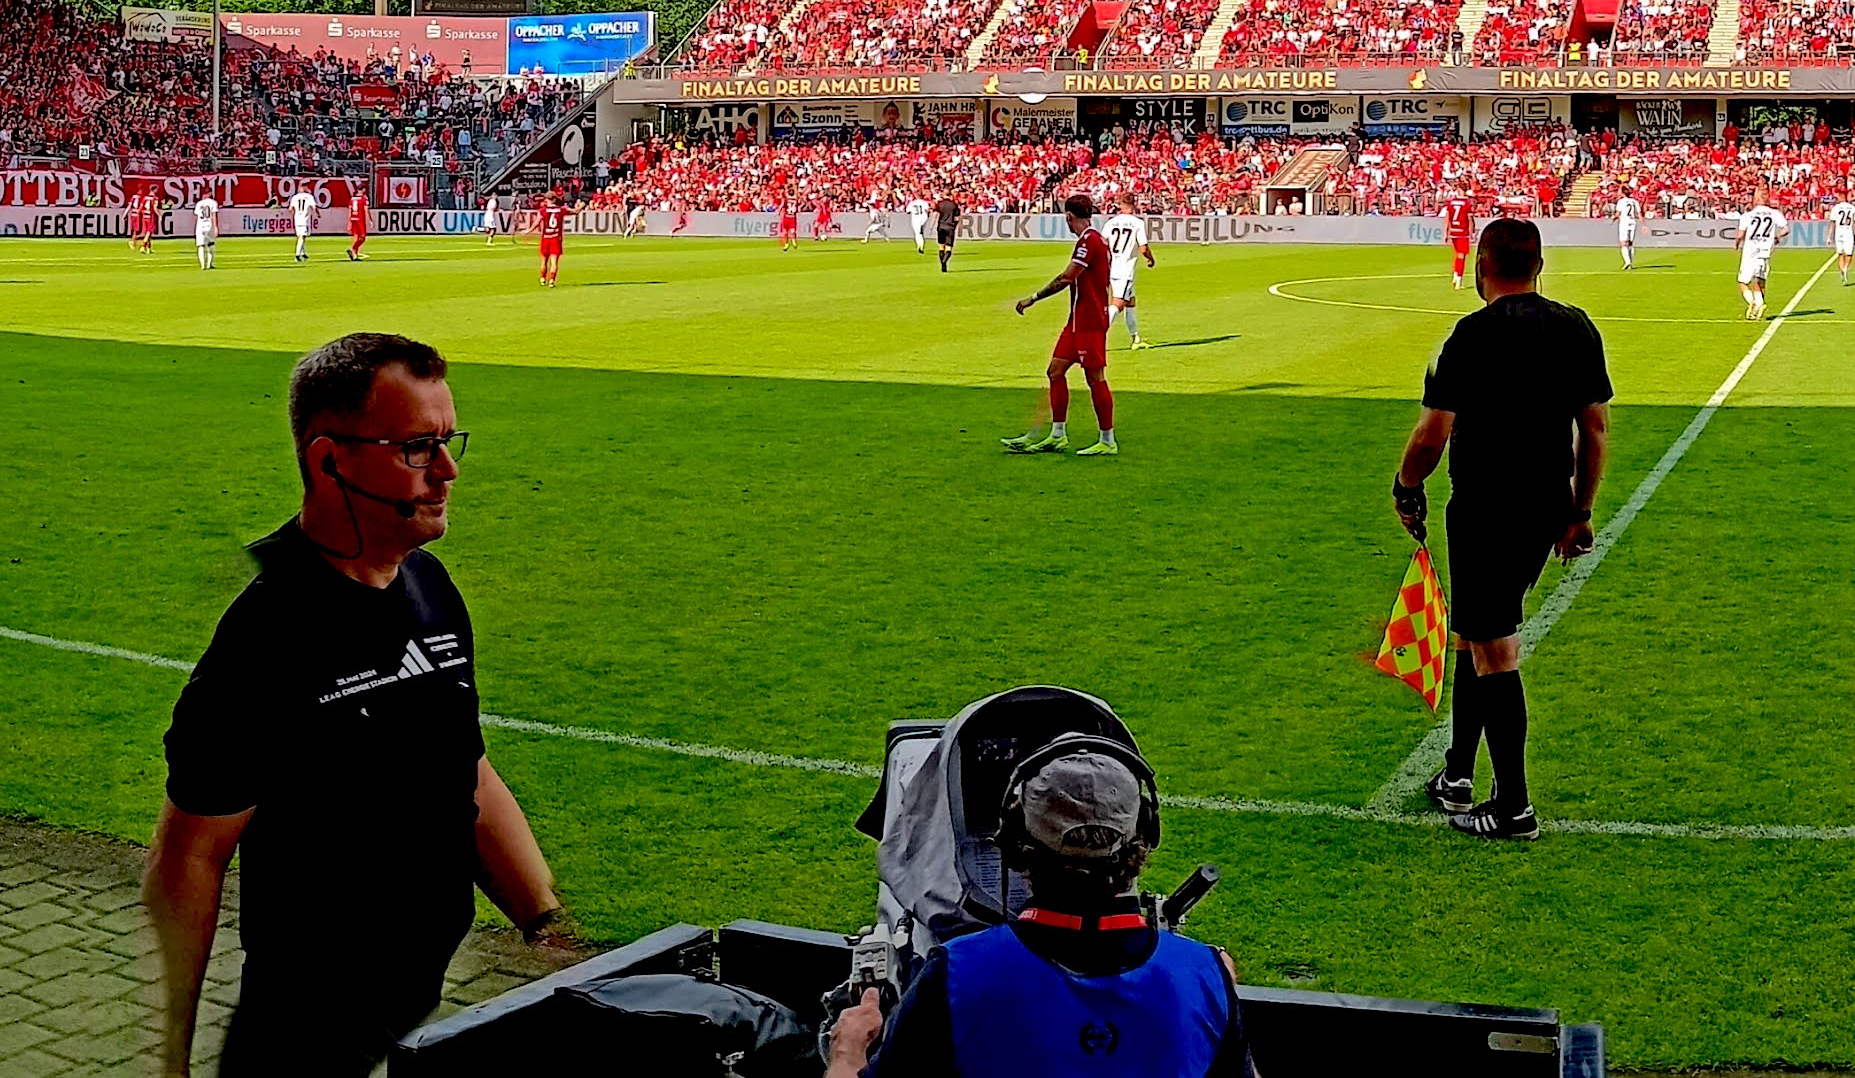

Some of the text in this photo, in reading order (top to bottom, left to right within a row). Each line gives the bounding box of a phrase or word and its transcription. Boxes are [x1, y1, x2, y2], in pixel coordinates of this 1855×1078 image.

[246, 25, 301, 38] Sparkasse
[346, 26, 400, 39] Sparkasse
[515, 25, 564, 38] OPPACHER
[588, 20, 640, 34] OPPACHER
[445, 29, 499, 41] Sparkasse
[1064, 71, 1337, 92] FINALTAG DER AMATEURE
[1500, 70, 1791, 89] FINALTAG DER AMATEURE
[682, 76, 922, 98] FINALTAG DER AMATEURE
[928, 102, 958, 112] JAHN
[1013, 107, 1076, 118] Malermeister
[1136, 100, 1194, 116] STYLE
[1247, 100, 1286, 115] TRC
[1300, 102, 1354, 119] OptiKon
[1387, 100, 1428, 114] TRC
[802, 112, 842, 124] Szonn
[1636, 109, 1683, 127] WAHN
[81, 147, 89, 157] 23
[432, 157, 442, 166] 25
[163, 174, 239, 209] SEIT
[200, 205, 211, 219] 30
[914, 206, 923, 216] 31
[1452, 203, 1463, 221] 7
[1838, 209, 1852, 226] 26
[378, 211, 436, 232] DRUCK
[548, 215, 557, 228] 6
[1751, 216, 1772, 239] 22
[1112, 228, 1132, 254] 27
